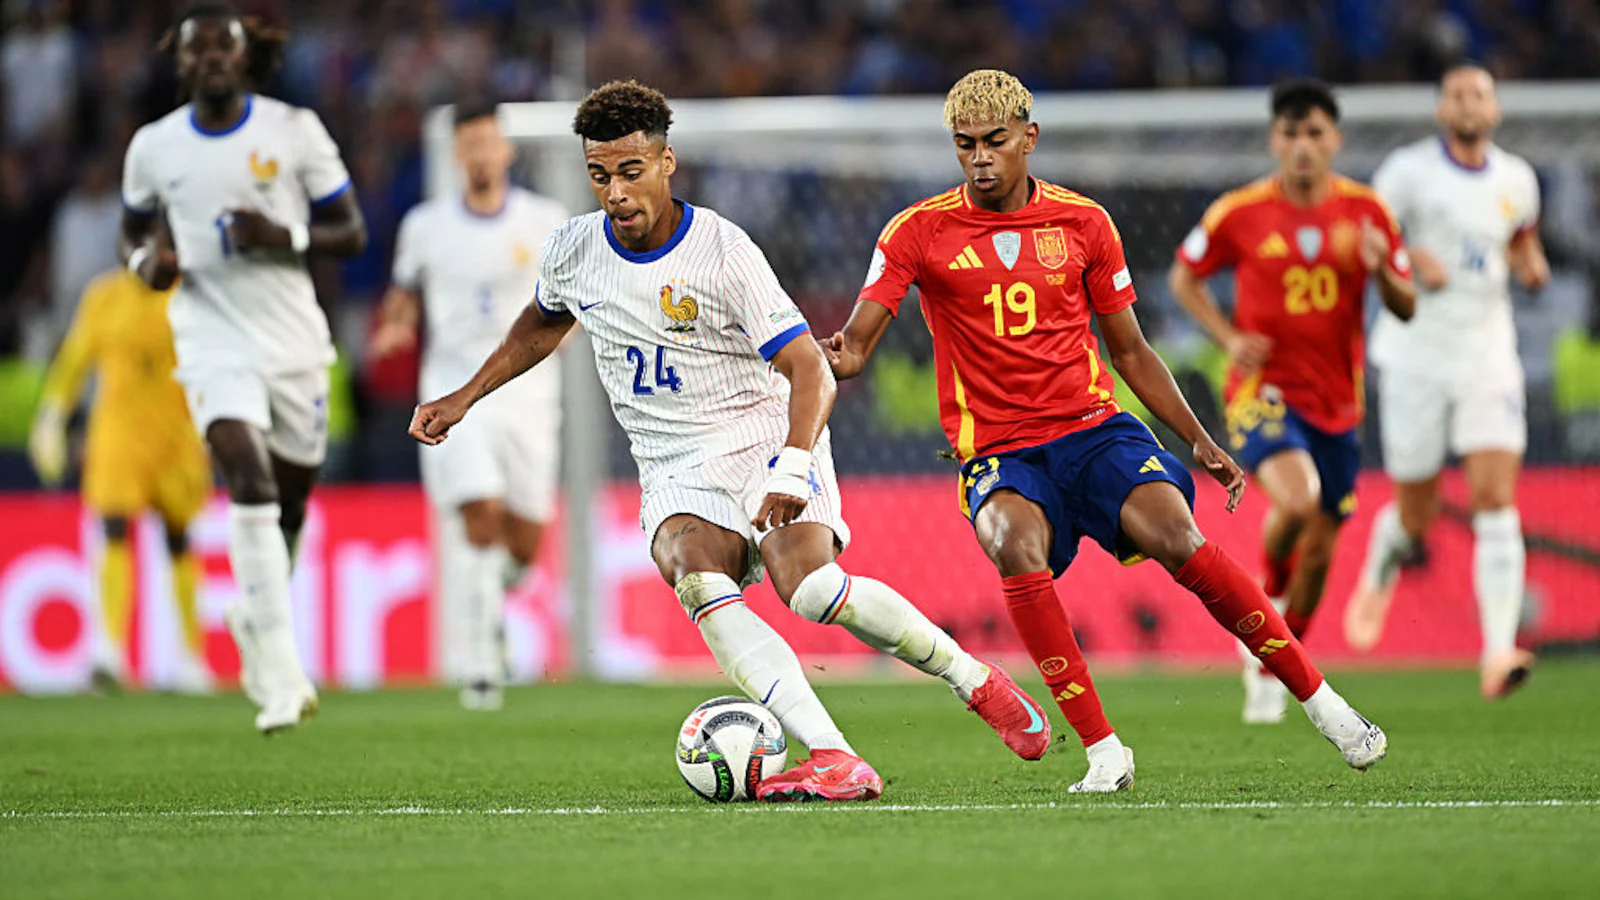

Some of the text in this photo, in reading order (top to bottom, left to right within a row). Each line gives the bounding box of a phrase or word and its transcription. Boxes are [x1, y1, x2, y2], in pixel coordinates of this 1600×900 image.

[983, 281, 1037, 337] 19
[1282, 264, 1338, 315] 20
[626, 345, 684, 396] 24
[708, 713, 756, 729] NATIONS
